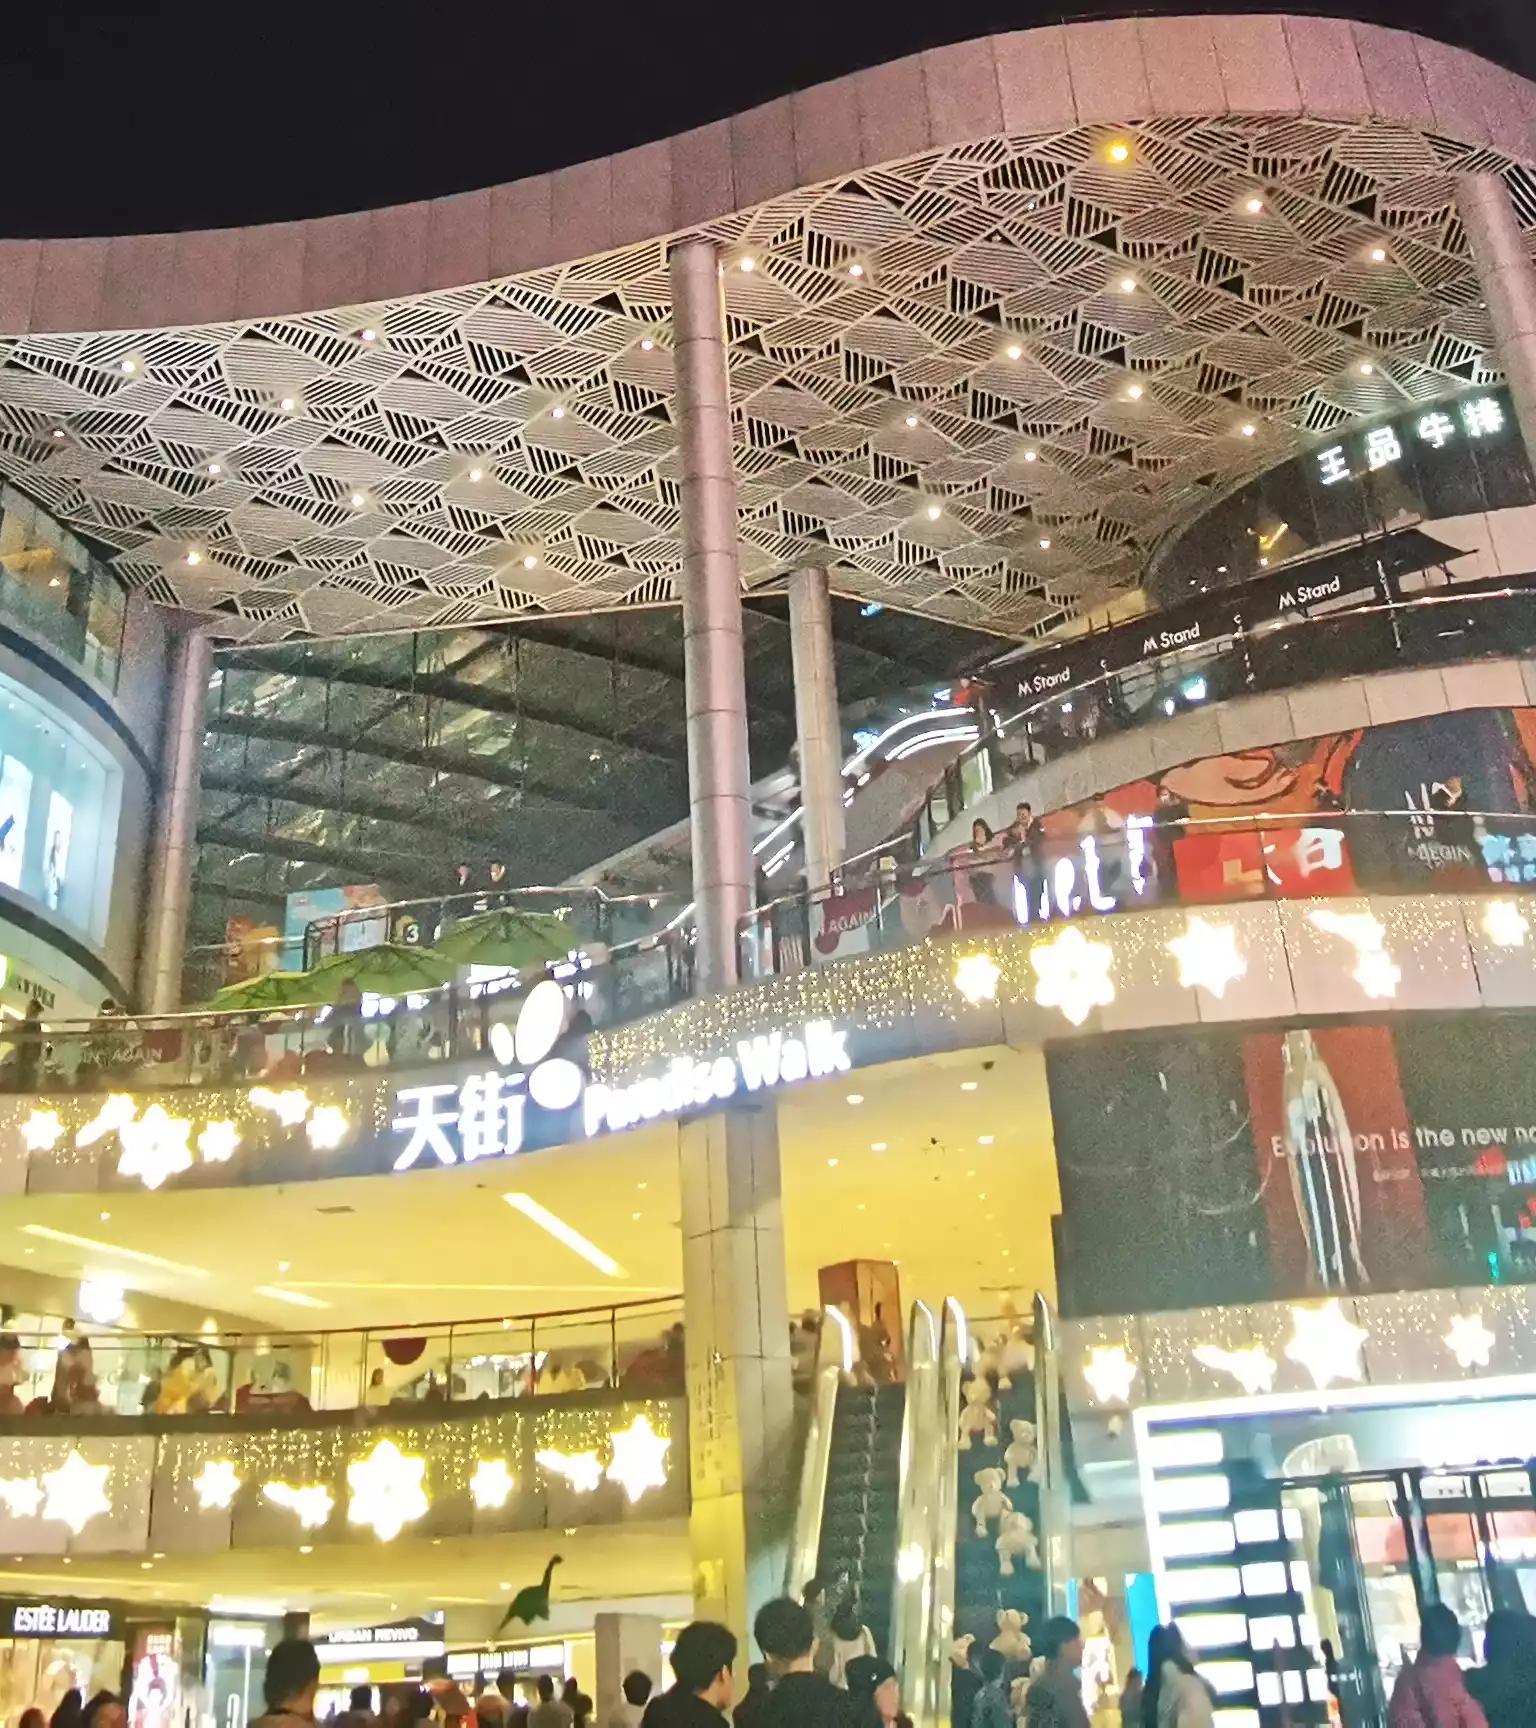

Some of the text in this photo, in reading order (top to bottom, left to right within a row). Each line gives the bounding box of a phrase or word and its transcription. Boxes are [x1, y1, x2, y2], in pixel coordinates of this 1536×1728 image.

[1316, 397, 1506, 486] 王品牛排
[1279, 576, 1341, 610] M Stand
[1144, 622, 1201, 654] M Stand
[1017, 666, 1071, 697] M Stand
[736, 1019, 853, 1093] Walk
[391, 1071, 527, 1170] 天街
[1415, 1126, 1455, 1147] the
[1462, 1127, 1507, 1146] new
[57, 1607, 111, 1633] LAUDER
